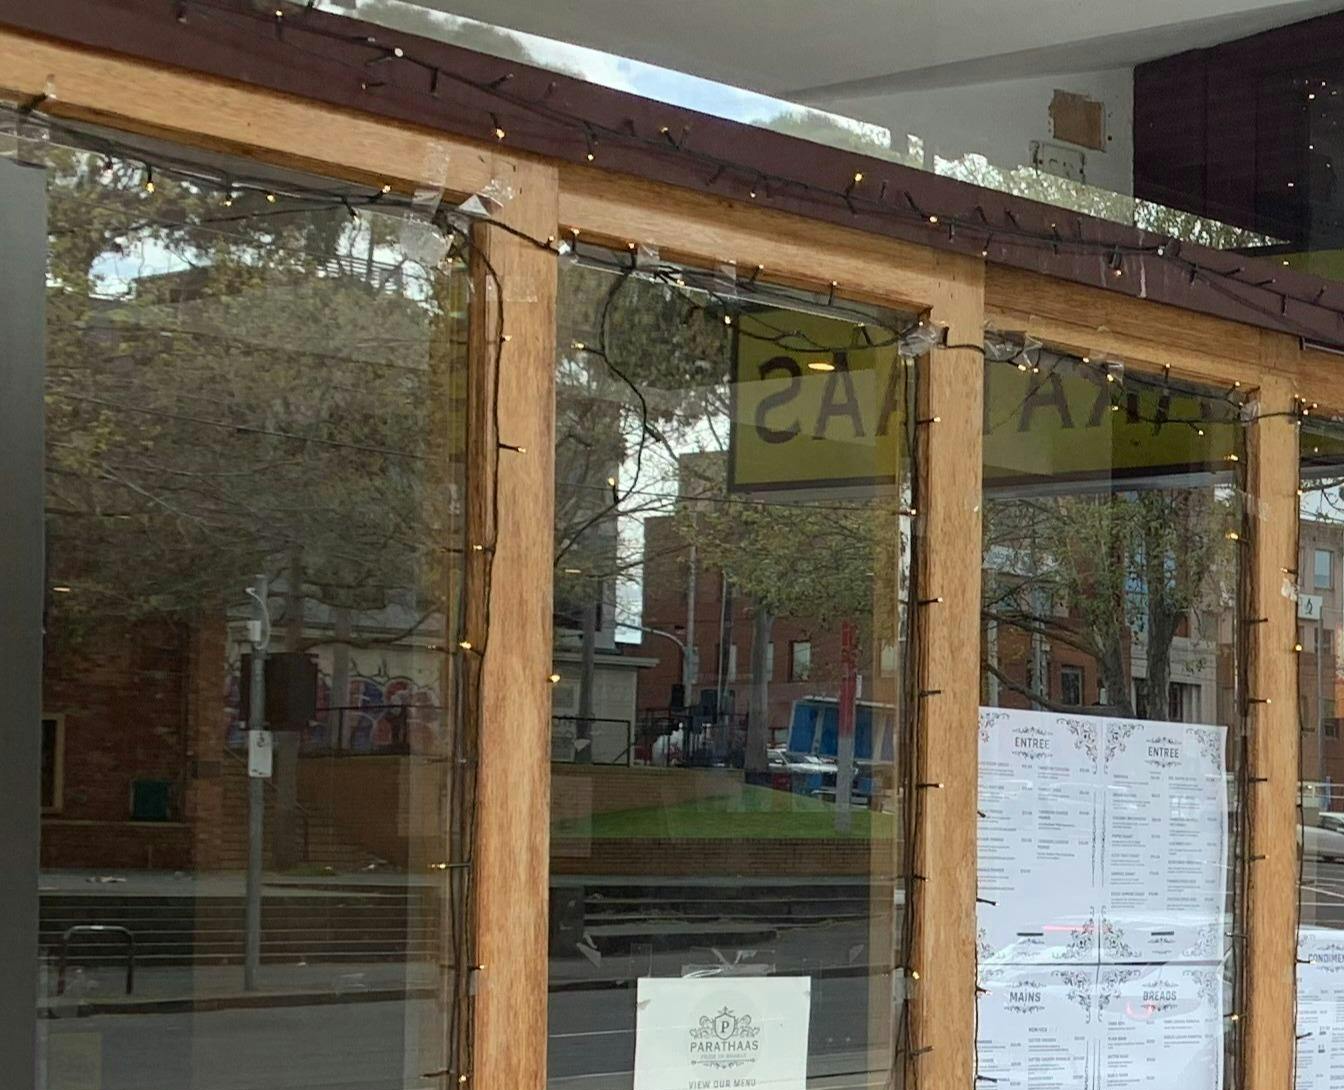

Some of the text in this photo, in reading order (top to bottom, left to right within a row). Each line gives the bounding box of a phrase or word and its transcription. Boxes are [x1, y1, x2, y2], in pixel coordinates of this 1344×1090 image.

[1015, 736, 1051, 750] ENTREE
[1147, 746, 1180, 759] ENTREE
[1009, 991, 1041, 1003] MAINS
[1143, 990, 1177, 1001] BREADS
[690, 1040, 759, 1053] PARATHAAS
[688, 1078, 757, 1090] VIEW OUR MENU
